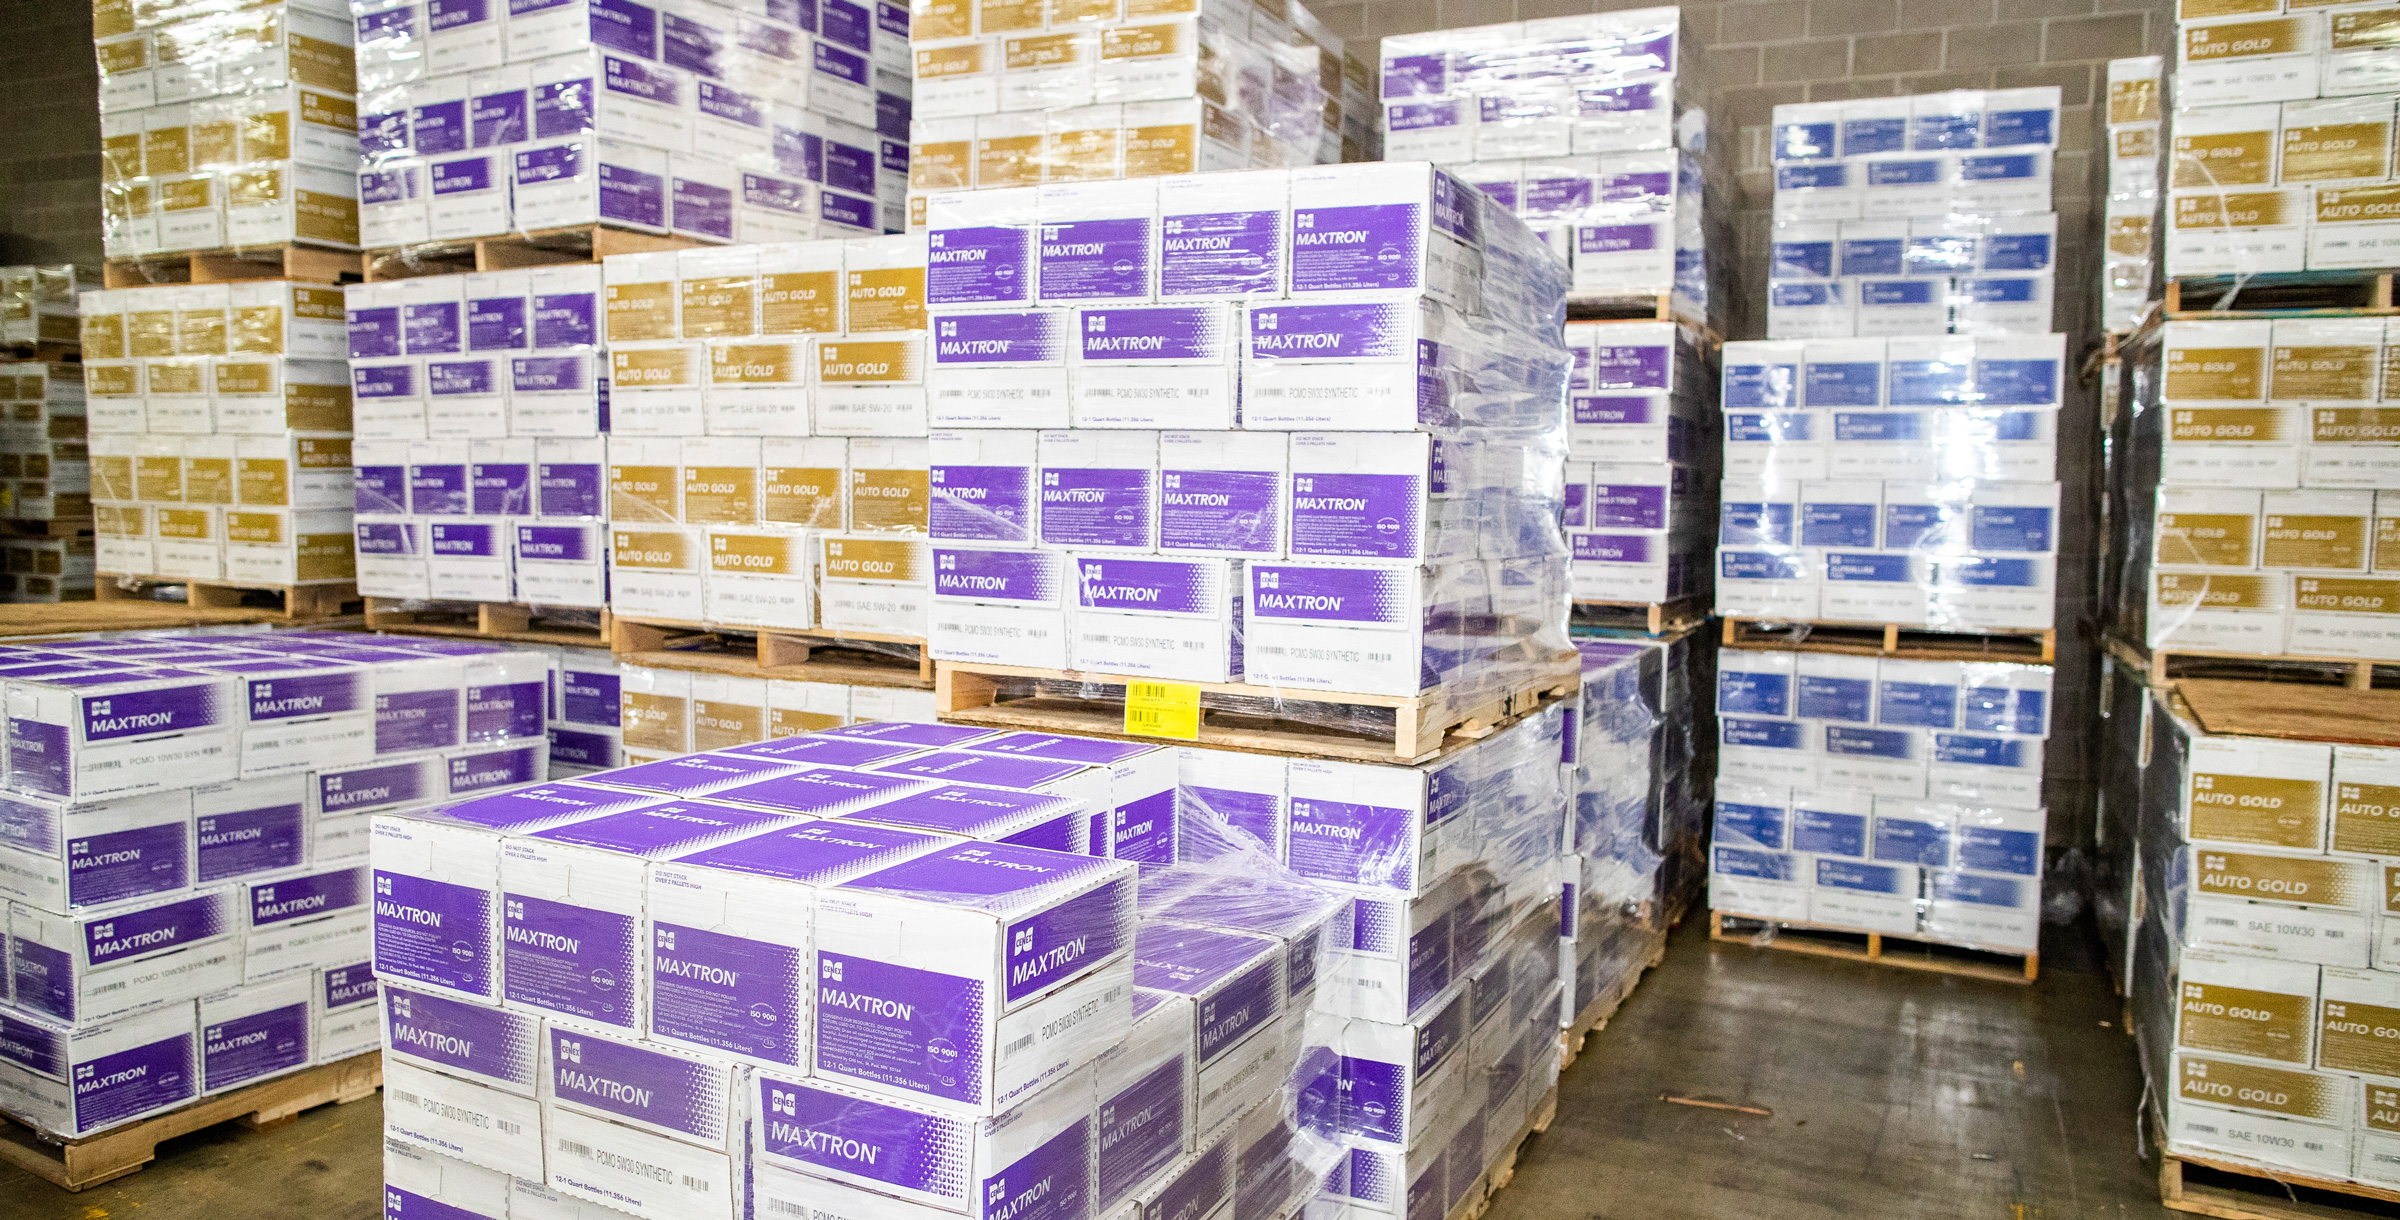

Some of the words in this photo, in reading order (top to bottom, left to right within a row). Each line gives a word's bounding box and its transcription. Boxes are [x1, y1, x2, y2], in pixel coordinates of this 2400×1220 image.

[2190, 43, 2228, 56] AUTO
[2232, 39, 2272, 52] GOLD
[2286, 141, 2318, 153] AUTO
[2321, 139, 2357, 151] GOLD
[1165, 237, 1230, 250] MAXTRON
[1296, 231, 1367, 246] MAXTRON
[930, 250, 986, 263] MAXTRON
[1042, 243, 1104, 258] MAXTRON
[763, 291, 786, 300] AUTO
[787, 289, 816, 300] GOLD
[850, 288, 875, 299] AUTO
[878, 286, 905, 297] GOLD
[940, 340, 1008, 355] MAXTRON
[1088, 336, 1162, 351] MAXTRON
[1257, 333, 1341, 350] MAXTRON
[617, 369, 642, 381] AUTO
[644, 368, 672, 381] GOLD
[715, 366, 742, 378] AUTO
[744, 365, 774, 377] GOLD
[823, 364, 854, 376] AUTO
[856, 362, 888, 375] GOLD
[2176, 426, 2212, 438] AUTO
[2215, 425, 2255, 438] GOLD
[2318, 426, 2356, 438] AUTO
[2360, 425, 2399, 438] GOLD
[686, 482, 708, 493] AUTO
[709, 483, 735, 494] GOLD
[767, 484, 790, 495] AUTO
[791, 484, 819, 495] GOLD
[854, 486, 880, 497] AUTO
[882, 486, 909, 497] GOLD
[932, 487, 986, 499] MAXTRON
[1044, 490, 1104, 503] MAXTRON
[1165, 493, 1228, 507] MAXTRON
[1296, 498, 1365, 511] MAXTRON
[2267, 529, 2299, 541] AUTO
[2302, 529, 2336, 541] GOLD
[617, 551, 642, 562] AUTO
[644, 551, 672, 563] GOLD
[714, 554, 742, 566] AUTO
[744, 555, 773, 567] GOLD
[829, 559, 859, 571] AUTO
[862, 560, 894, 573] GOLD
[939, 574, 1007, 590] MAXTRON
[1085, 586, 1159, 602] MAXTRON
[1259, 593, 1340, 611] MAXTRON
[2300, 595, 2338, 607] AUTO
[2342, 596, 2383, 608] GOLD
[1291, 648, 1308, 659] PCMO
[1309, 649, 1325, 660] 5W30
[1326, 650, 1360, 662] SYNTHETIC
[254, 696, 322, 715] MAXTRON
[469, 699, 514, 711] MAXTRON
[91, 713, 172, 734] MAXTRON
[696, 717, 718, 728] AUTO
[719, 719, 743, 731] GOLD
[772, 725, 795, 736] AUTO
[453, 769, 509, 788] MAXTRON
[326, 785, 390, 806] MAXTRON
[2194, 792, 2235, 805] AUTO
[2239, 795, 2281, 809] GOLD
[2339, 804, 2383, 817] AUTO
[1116, 820, 1153, 844] MAXTRON
[1292, 821, 1361, 839] MAXTRON
[200, 829, 261, 848] MAXTRON
[72, 850, 140, 869] MAXTRON
[2202, 873, 2251, 889] AUTO
[2257, 878, 2308, 895] GOLD
[257, 894, 325, 919] MAXTRON
[377, 901, 441, 927] MAXTRON
[2248, 921, 2272, 933] SAE
[2276, 924, 2315, 937] 10W30
[94, 927, 175, 957] MAXTRON
[507, 926, 578, 954] MAXTRON
[461, 949, 474, 957] 9001
[1012, 935, 1086, 987] MAXTRON
[656, 955, 736, 988] MAXTRON
[590, 975, 600, 983] ISO
[602, 977, 615, 986] 9001
[821, 987, 912, 1021] MAXTRON
[2184, 1001, 2224, 1016] AUTO
[2229, 1007, 2271, 1022] GOLD
[750, 1010, 761, 1018] ISO
[763, 1012, 777, 1022] 9001
[1041, 1019, 1058, 1042] PCMO
[1059, 1012, 1072, 1037] 5W30
[1071, 998, 1099, 1029] SYNTHETIC
[1202, 1006, 1249, 1050] MAXTRON
[208, 1031, 268, 1054] MAXTRON
[395, 1023, 470, 1058] MAXTRON
[657, 1025, 670, 1034] 12-1
[671, 1029, 688, 1038] Quart
[689, 1032, 710, 1043] Bottles
[710, 1036, 733, 1049] (11.356
[734, 1042, 753, 1054] Liters)
[927, 1045, 939, 1054] ISO
[941, 1048, 958, 1058] 9001
[77, 1066, 147, 1094] MAXTRON
[823, 1060, 836, 1069] 12-1
[838, 1064, 857, 1074] Quart
[858, 1067, 881, 1079] Bottles
[882, 1073, 907, 1085] (11.356
[909, 1079, 930, 1092] Liters)
[560, 1068, 649, 1108] MAXTRON
[2184, 1080, 2233, 1097] AUTO
[2238, 1088, 2288, 1105] GOLD
[423, 1098, 440, 1115] PCMO
[440, 1104, 456, 1120] 5W30
[457, 1108, 490, 1130] SYNTHETIC
[1102, 1106, 1152, 1152] MAXTRON
[772, 1121, 877, 1164] MAXTRON
[2228, 1129, 2252, 1142] SAE
[2256, 1134, 2294, 1148] 10W30
[596, 1149, 616, 1168] PCMO
[617, 1155, 634, 1174] 5W30
[635, 1160, 673, 1185] SYNTHETIC
[555, 1175, 567, 1183] 12-1
[568, 1178, 583, 1189] Quart
[584, 1183, 603, 1195] Bottles
[603, 1188, 623, 1201] (11.356
[625, 1195, 642, 1208] Liters)
